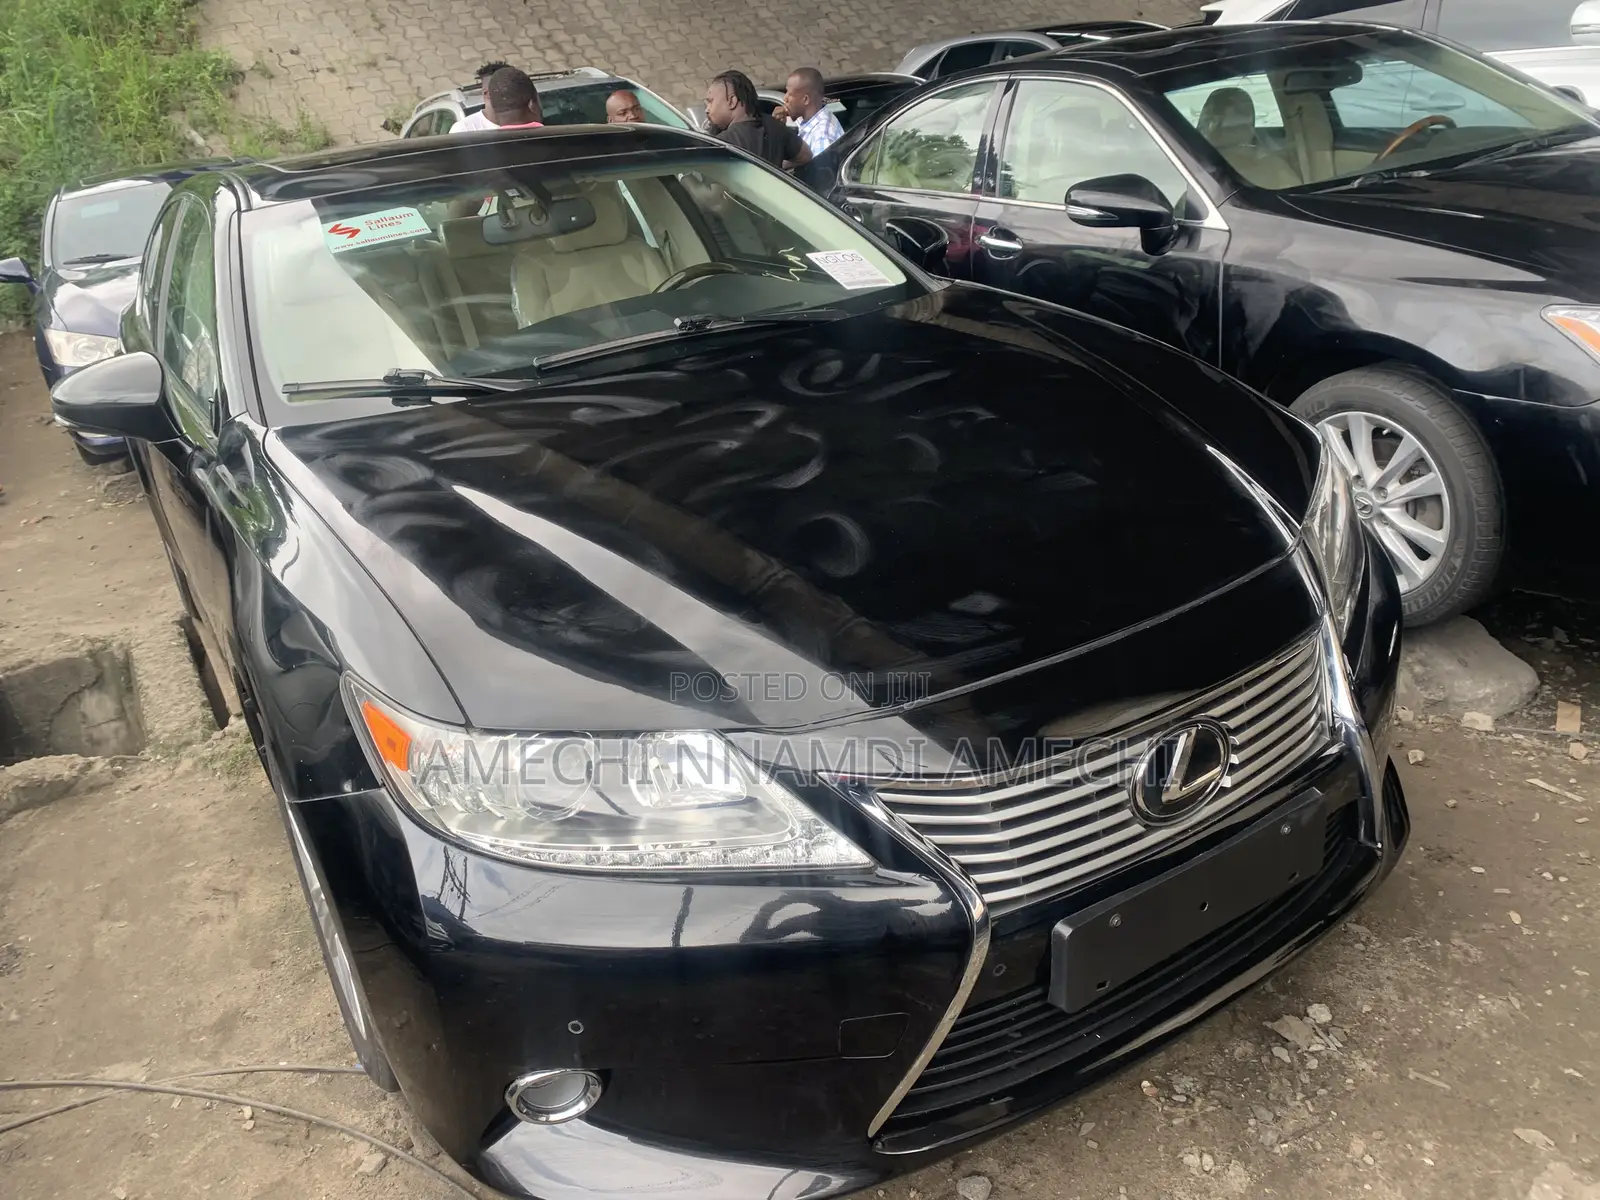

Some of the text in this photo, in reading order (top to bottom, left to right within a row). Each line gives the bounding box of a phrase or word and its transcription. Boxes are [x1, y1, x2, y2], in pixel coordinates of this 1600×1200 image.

[365, 212, 414, 226] Sallaum
[368, 221, 402, 231] Lines
[334, 227, 428, 250] www.sallaumlines.com
